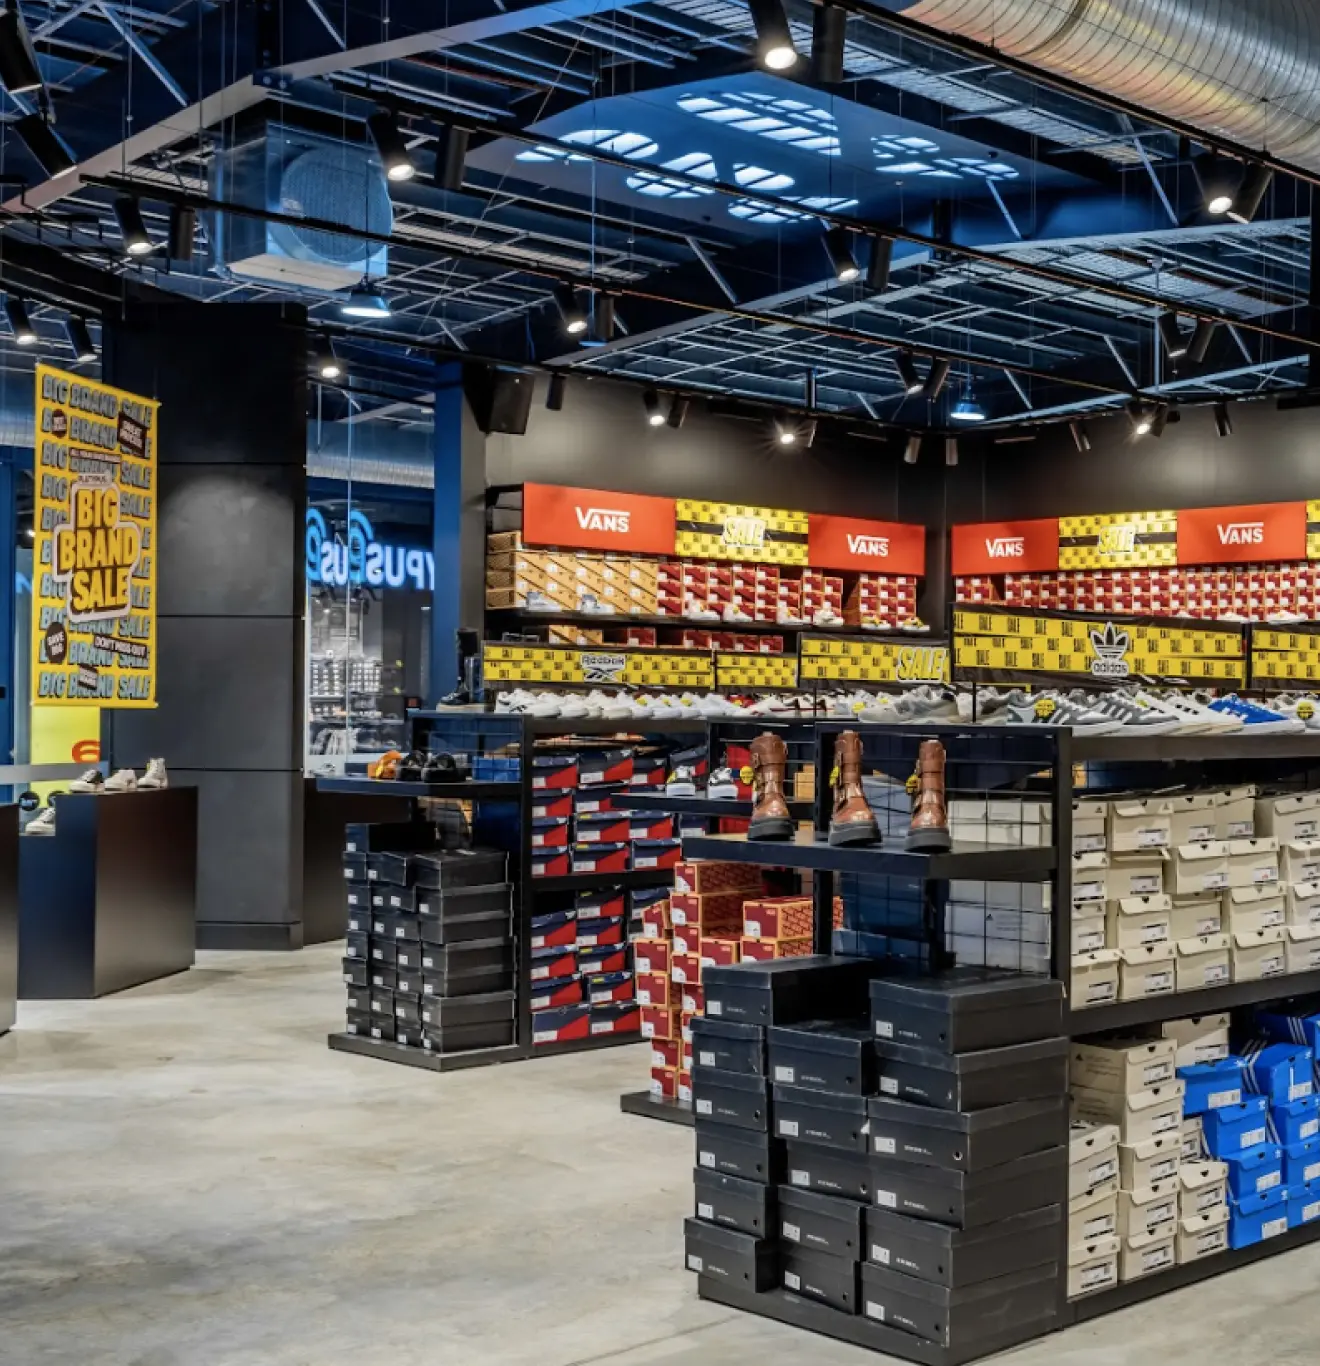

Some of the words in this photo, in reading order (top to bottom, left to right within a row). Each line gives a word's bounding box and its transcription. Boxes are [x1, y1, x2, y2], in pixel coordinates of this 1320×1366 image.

[43, 374, 69, 405] BIG
[69, 384, 118, 419] BRAND
[70, 416, 118, 450] BRAND
[42, 441, 68, 469] BIG
[121, 461, 151, 489] SALE
[77, 488, 118, 528] BIG
[575, 507, 631, 533] VANS
[847, 533, 889, 557] VANS
[986, 537, 1024, 557] VANS
[1217, 521, 1264, 545] VANS
[58, 529, 138, 571] BRAND
[72, 567, 130, 612] SALE
[119, 614, 151, 639] SALE
[898, 649, 942, 680] SALE
[1094, 663, 1128, 674] adidas
[39, 672, 66, 699] BIG
[118, 675, 151, 699] SALE
